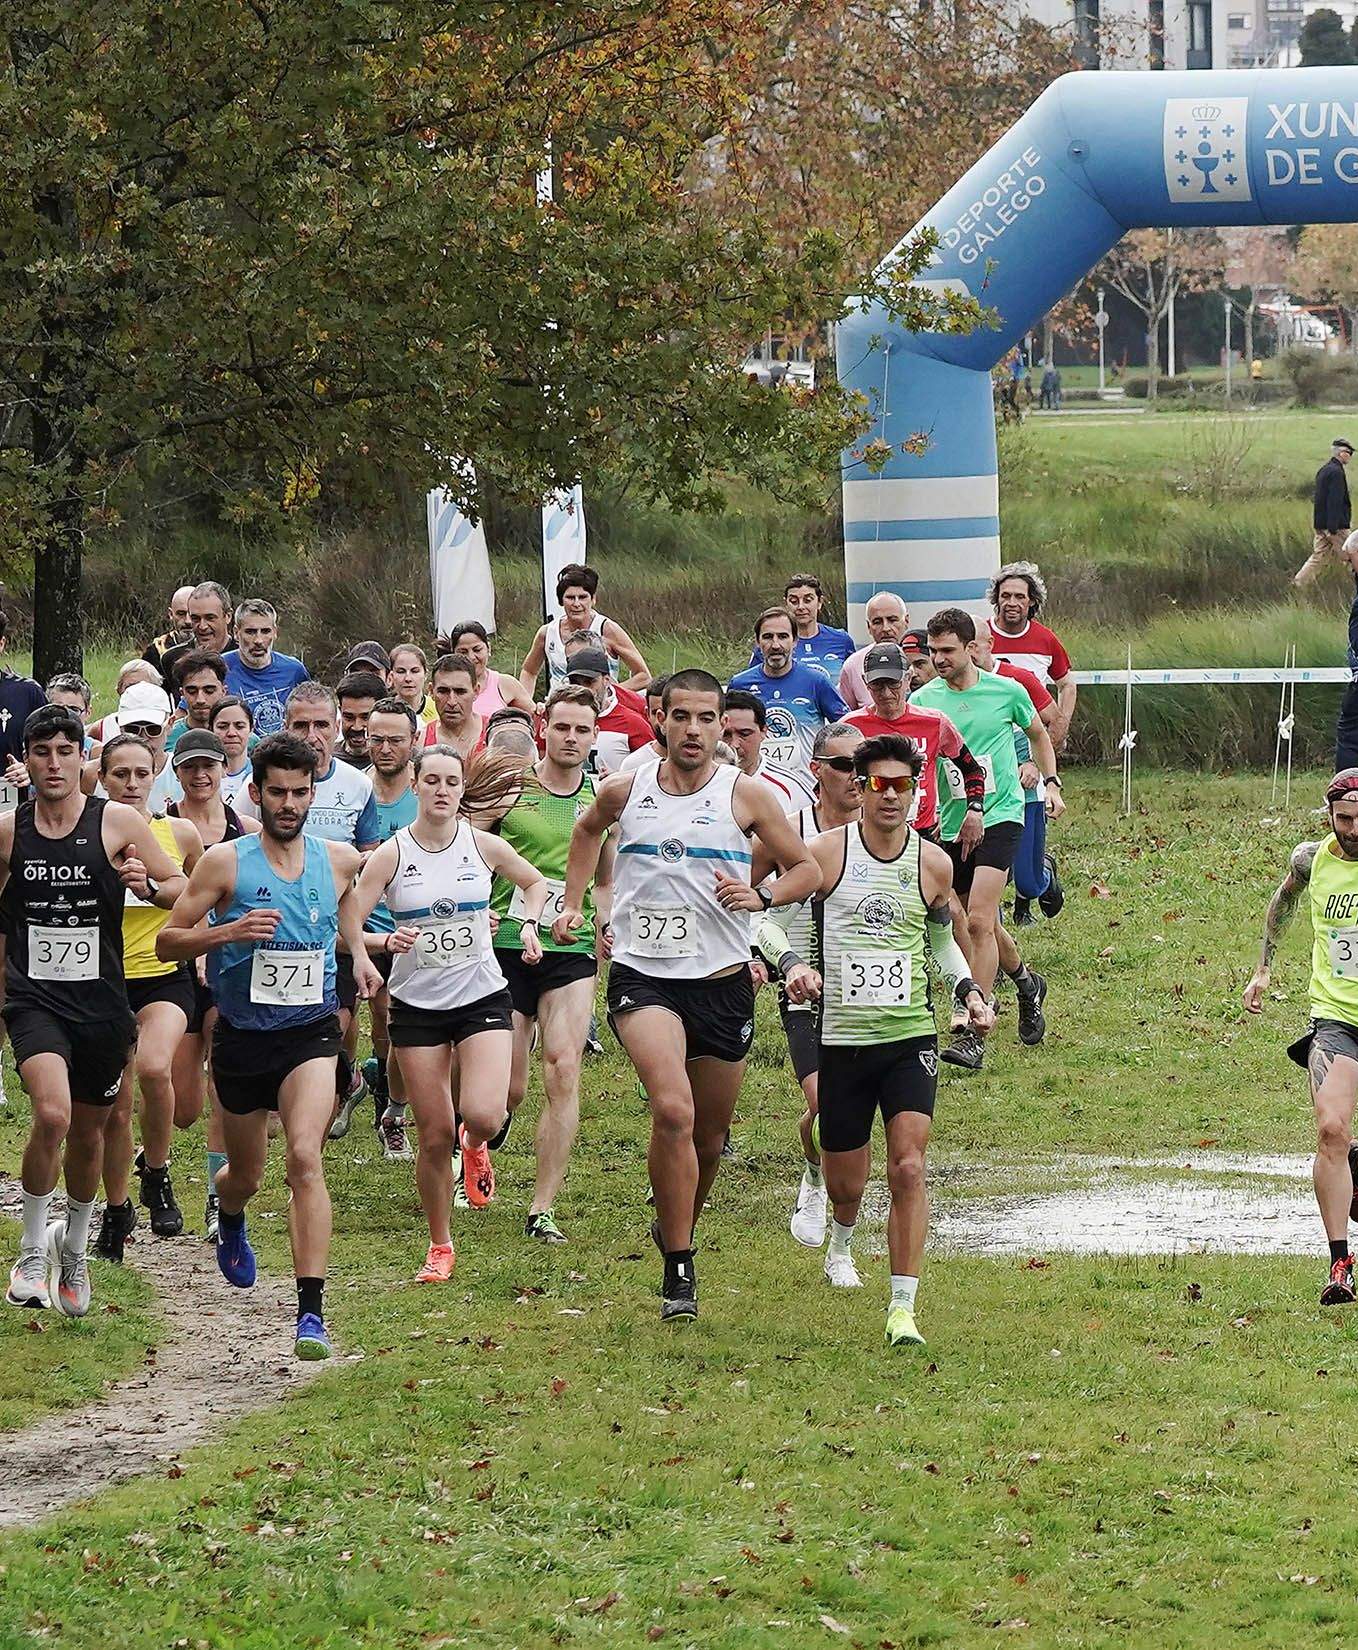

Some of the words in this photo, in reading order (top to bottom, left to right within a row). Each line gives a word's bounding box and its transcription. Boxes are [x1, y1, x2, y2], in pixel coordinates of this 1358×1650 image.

[1265, 148, 1323, 186] DE
[943, 146, 1041, 249] DEPORTE
[958, 175, 1046, 264] GALEGO
[1325, 893, 1358, 919] RISE
[422, 926, 473, 953] 363
[638, 915, 687, 940] 373
[38, 940, 91, 964] 379
[261, 964, 314, 988] 371
[851, 964, 903, 988] 338
